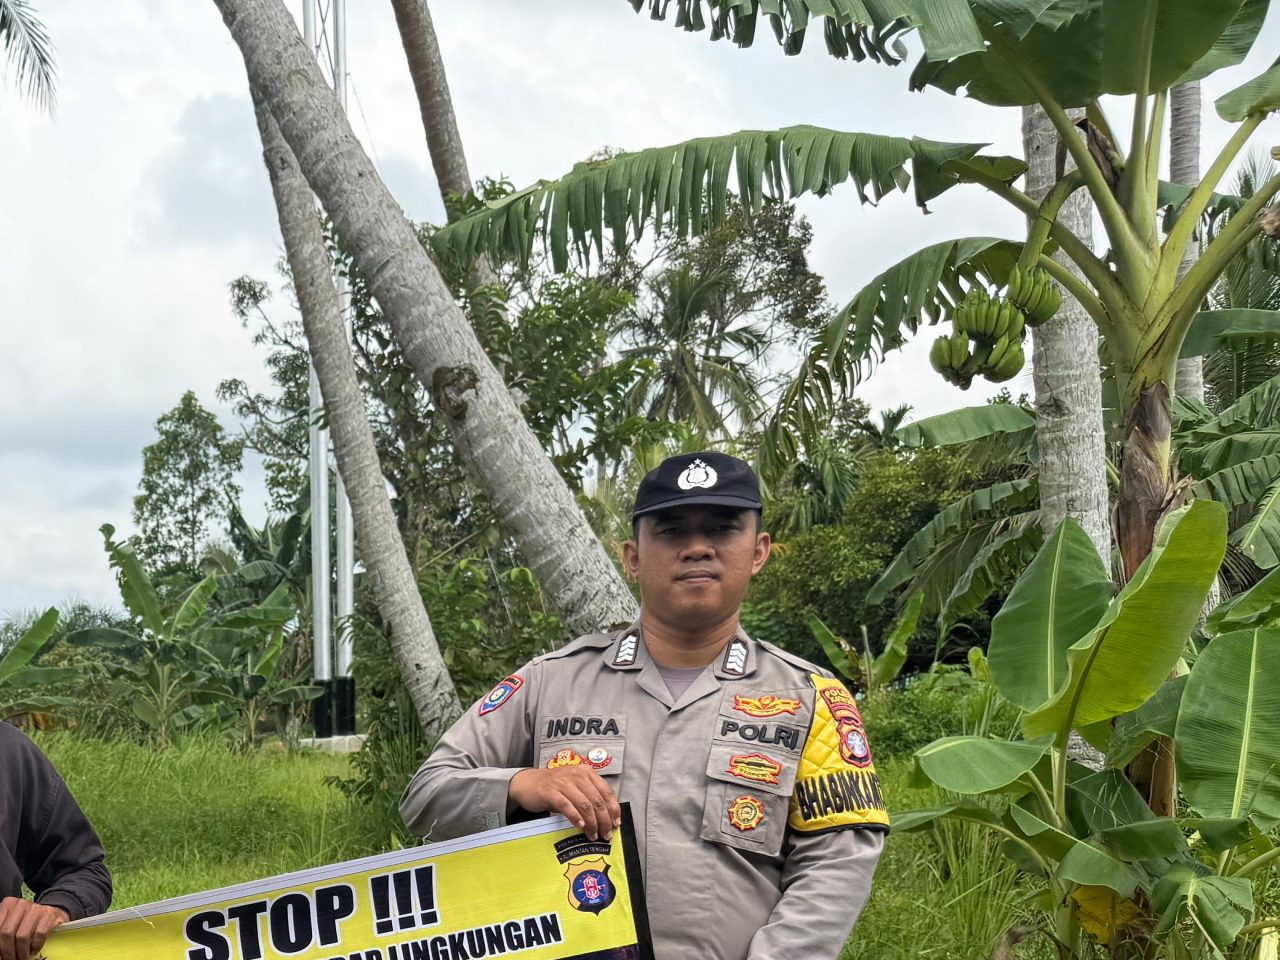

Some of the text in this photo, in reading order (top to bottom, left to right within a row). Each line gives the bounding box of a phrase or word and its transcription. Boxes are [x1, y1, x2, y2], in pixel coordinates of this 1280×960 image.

[546, 716, 620, 739] INDRA
[720, 720, 800, 750] POLRI
[795, 769, 887, 822] BHABINKAM
[370, 865, 439, 935] !!!
